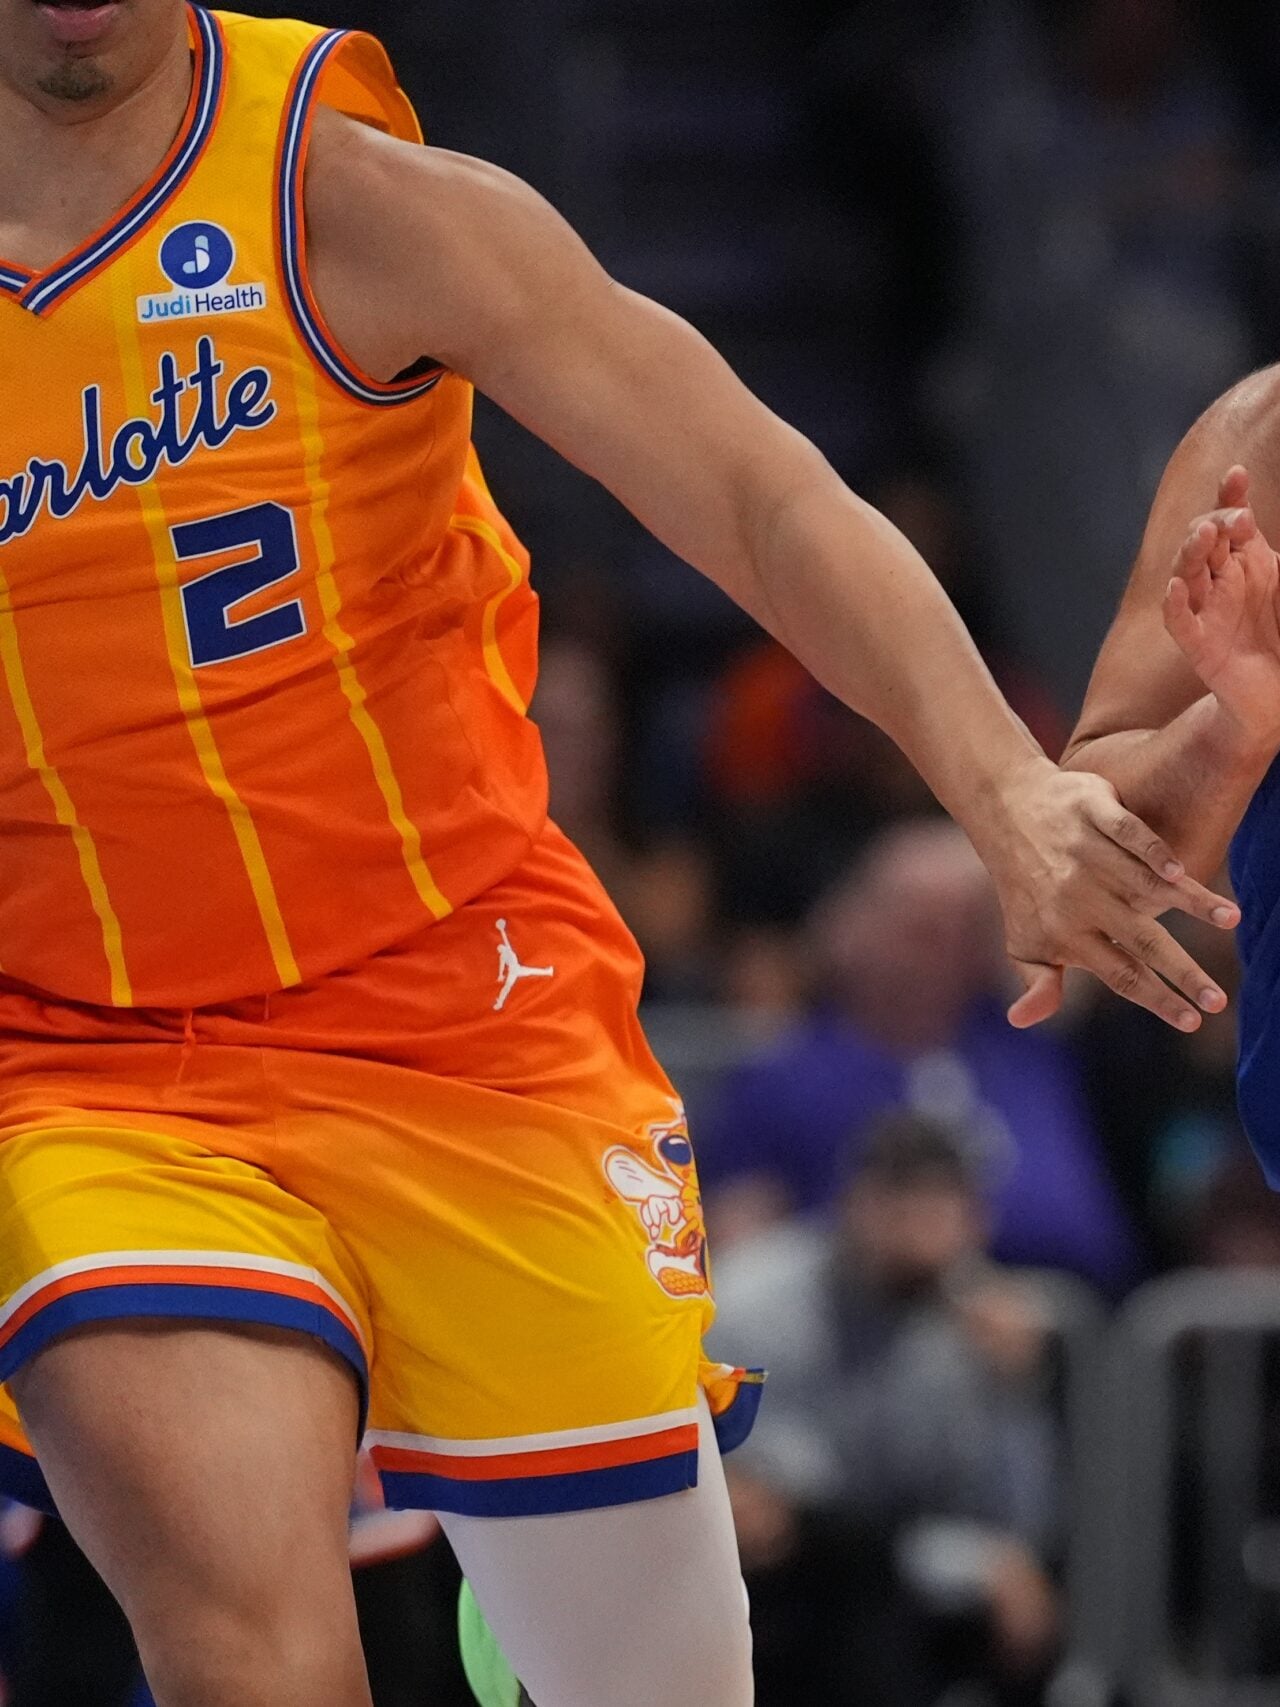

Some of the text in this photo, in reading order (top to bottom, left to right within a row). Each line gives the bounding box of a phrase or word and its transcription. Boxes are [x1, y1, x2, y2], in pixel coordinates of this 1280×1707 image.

[141, 286, 263, 319] Judi Health
[169, 500, 308, 669] 2
